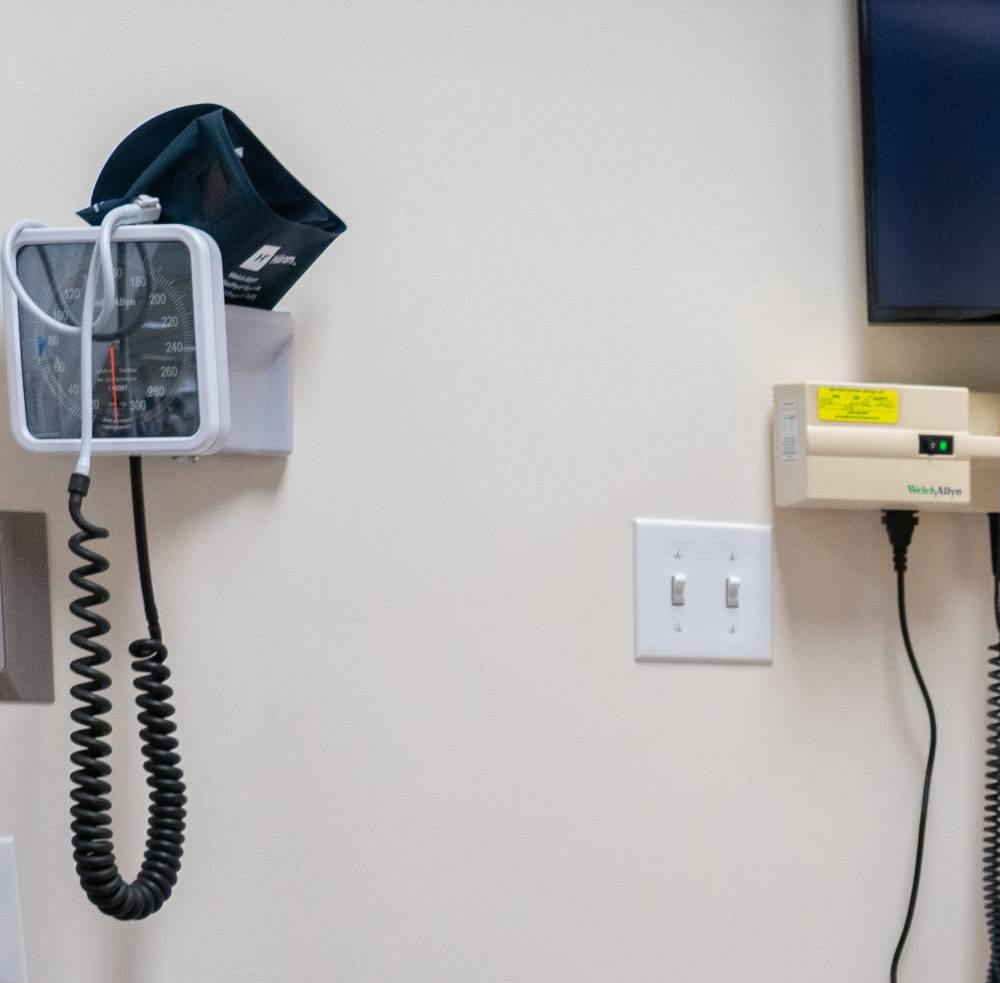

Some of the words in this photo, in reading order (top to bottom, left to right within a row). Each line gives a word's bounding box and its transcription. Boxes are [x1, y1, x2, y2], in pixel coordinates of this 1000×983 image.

[149, 293, 167, 304] 200
[161, 316, 179, 327] 220
[166, 341, 183, 352] 240
[160, 366, 178, 377] 260
[129, 400, 146, 411] 300
